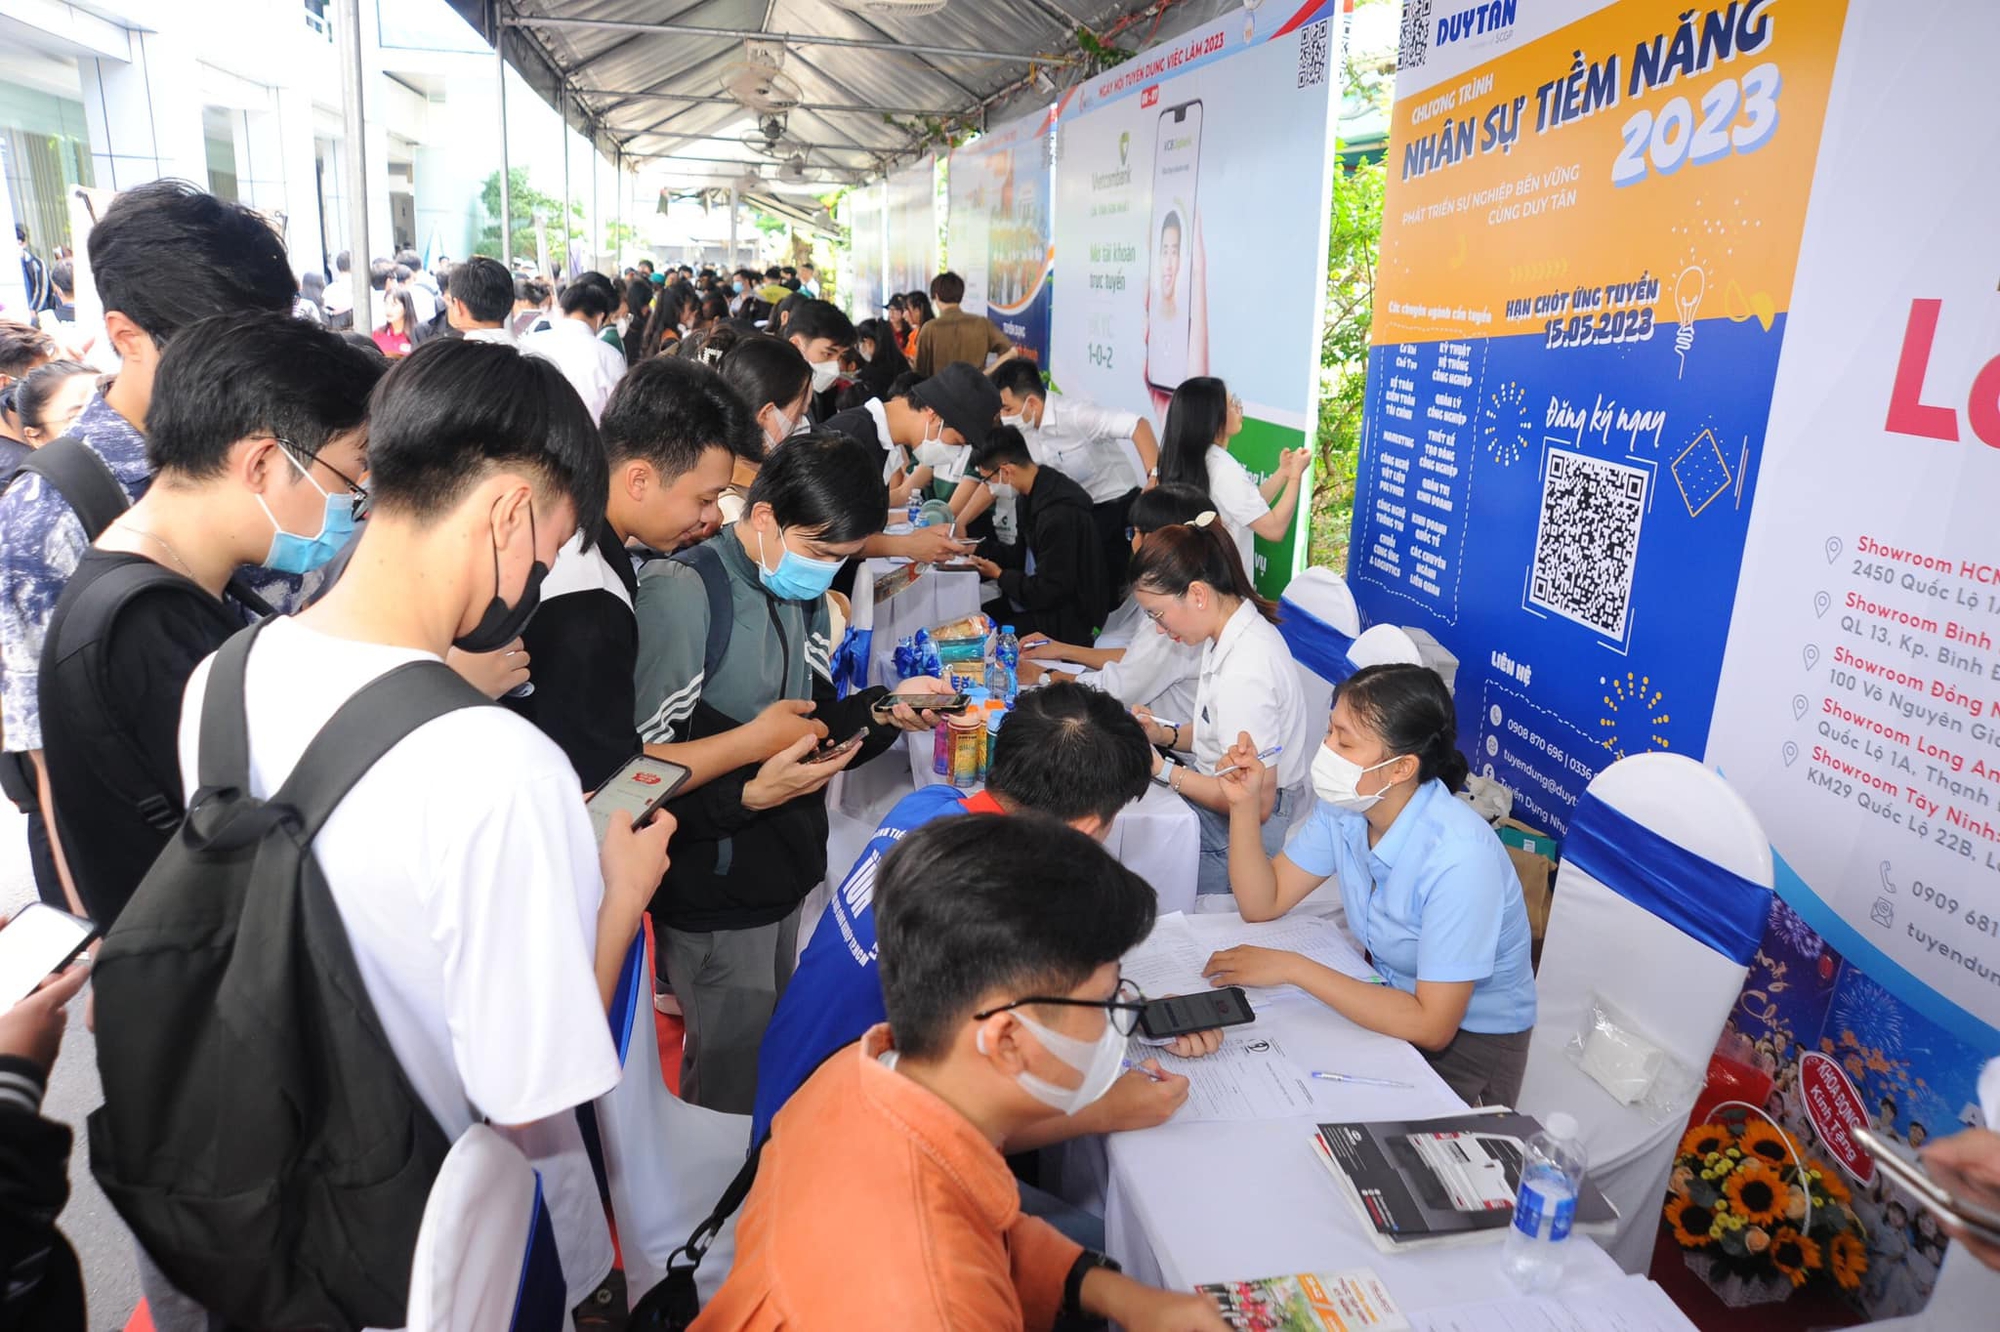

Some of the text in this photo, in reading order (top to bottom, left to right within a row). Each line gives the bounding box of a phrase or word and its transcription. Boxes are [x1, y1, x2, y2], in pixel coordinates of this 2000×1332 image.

[1167, 48, 1183, 71] VIỆC
[1185, 38, 1202, 63] LÀM
[1203, 32, 1224, 54] 2023
[1402, 0, 1777, 183] NHÂN SỰ TIỀM NĂNG
[1411, 72, 1495, 126] CHƯƠNG TRÌNH
[1611, 62, 1783, 189] 2023
[1402, 164, 1581, 226] PHÁT TRIỂN SỰ NGHIỆP BỀN VỮNG
[1487, 189, 1577, 226] CÙNG DUY TÂN
[1505, 298, 1532, 324] HẠN
[1572, 284, 1603, 312] ỨNG
[1605, 270, 1661, 308] TUYỂN
[1087, 342, 1113, 370] 1-0-2
[1545, 307, 1657, 350] 15.05.2023
[1546, 393, 1666, 453] Đăng ký ngay
[1857, 535, 1953, 575] Showroom
[1845, 591, 1938, 634] Showroom
[1851, 559, 1896, 585] 2450
[1900, 573, 1950, 600] Quốc
[1956, 587, 1979, 611] Lộ
[1840, 615, 1864, 636] QL
[1899, 633, 1929, 659] Kp.
[1491, 650, 1532, 687] LIÊN HỆ
[1833, 646, 1924, 692] Showroom
[1930, 681, 1983, 718] Đồng
[1829, 668, 1856, 691] 100
[1863, 681, 1883, 702] Võ
[1888, 692, 1963, 734] Nguyên
[1507, 718, 1529, 741] 0908
[1529, 730, 1546, 751] 870
[1547, 743, 1564, 763] 696
[1569, 757, 1592, 780] 0336
[1818, 720, 1860, 750] Quốc
[1864, 740, 1884, 764] Lộ
[1925, 765, 1990, 806] Thạnh
[1822, 697, 1910, 747] Showroom
[1916, 735, 1964, 773] Long
[1503, 749, 1579, 808] tuyendung@duyt
[1807, 766, 1853, 798] KM29
[1857, 792, 1903, 824] Quốc
[1908, 815, 1929, 839] Lộ
[1812, 745, 1899, 797] Showroom
[1905, 787, 1939, 818] Tây
[1525, 796, 1549, 823] Dụng
[1912, 880, 1999, 938] 0909 681
[1816, 1061, 1841, 1099] KHOA
[1810, 1084, 1857, 1162] Kính Tặng
